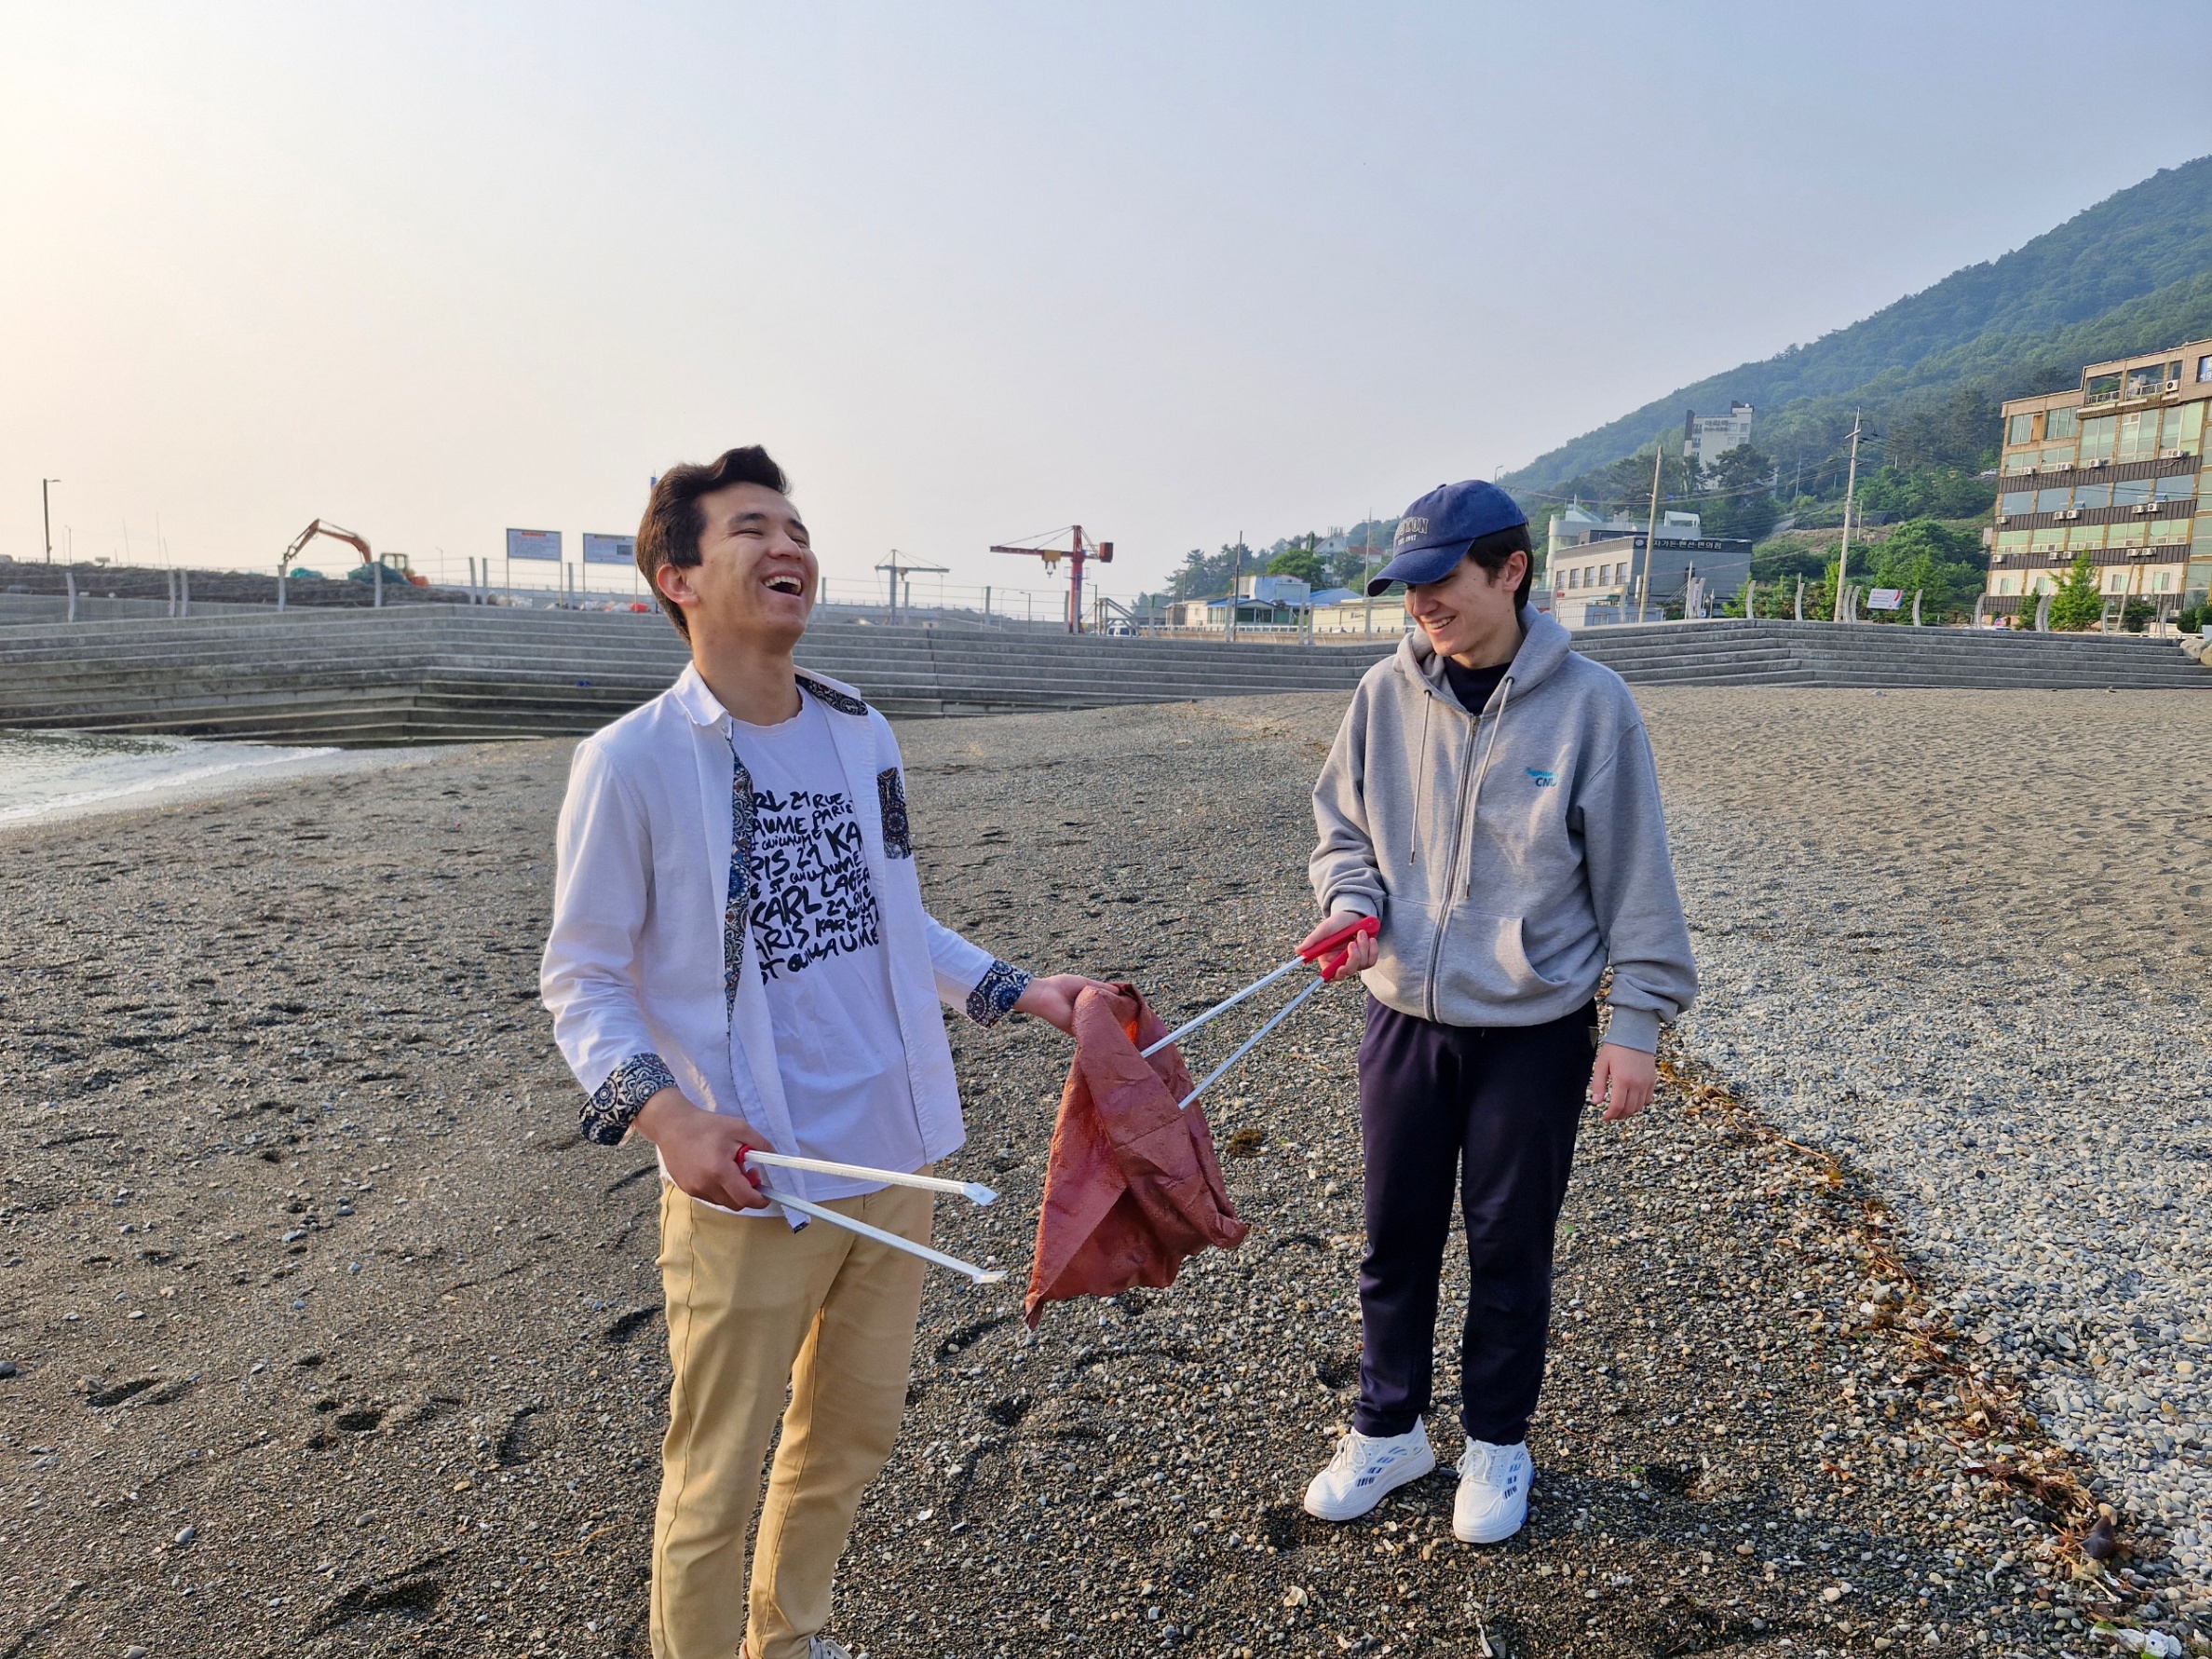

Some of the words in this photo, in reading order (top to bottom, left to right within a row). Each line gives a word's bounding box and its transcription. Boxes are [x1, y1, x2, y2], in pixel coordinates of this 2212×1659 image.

[1535, 773, 1559, 788] CNU
[812, 793, 846, 809] RUE
[814, 918, 858, 938] KARL
